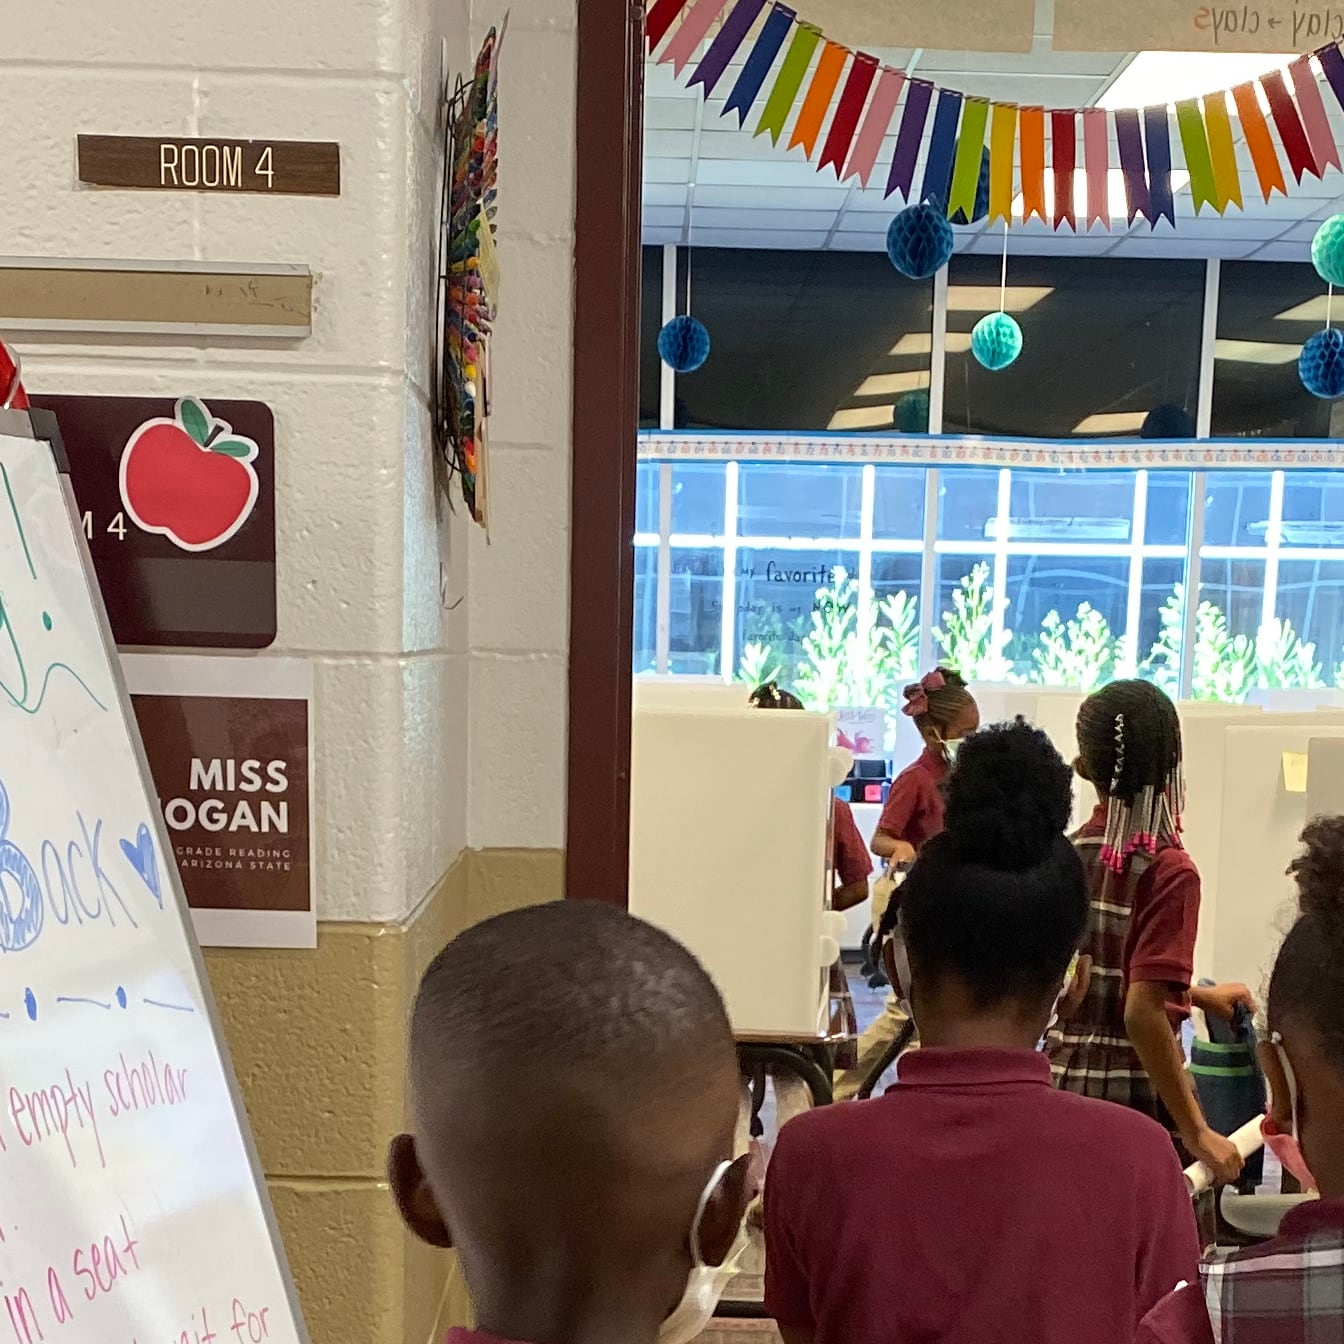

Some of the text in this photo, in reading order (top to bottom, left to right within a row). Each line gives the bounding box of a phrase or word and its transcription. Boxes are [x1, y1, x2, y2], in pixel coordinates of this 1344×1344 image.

[160, 144, 274, 188] ROOM 4
[107, 511, 128, 541] 4
[766, 560, 836, 584] favorite
[189, 758, 289, 792] MISS
[164, 798, 289, 833] OGAN
[181, 858, 291, 871] ARIZONA STATE
[229, 847, 291, 859] READING
[9, 1068, 107, 1169] empty
[104, 1050, 189, 1117] scholar
[48, 1265, 74, 1325] a
[73, 1213, 141, 1301] seat
